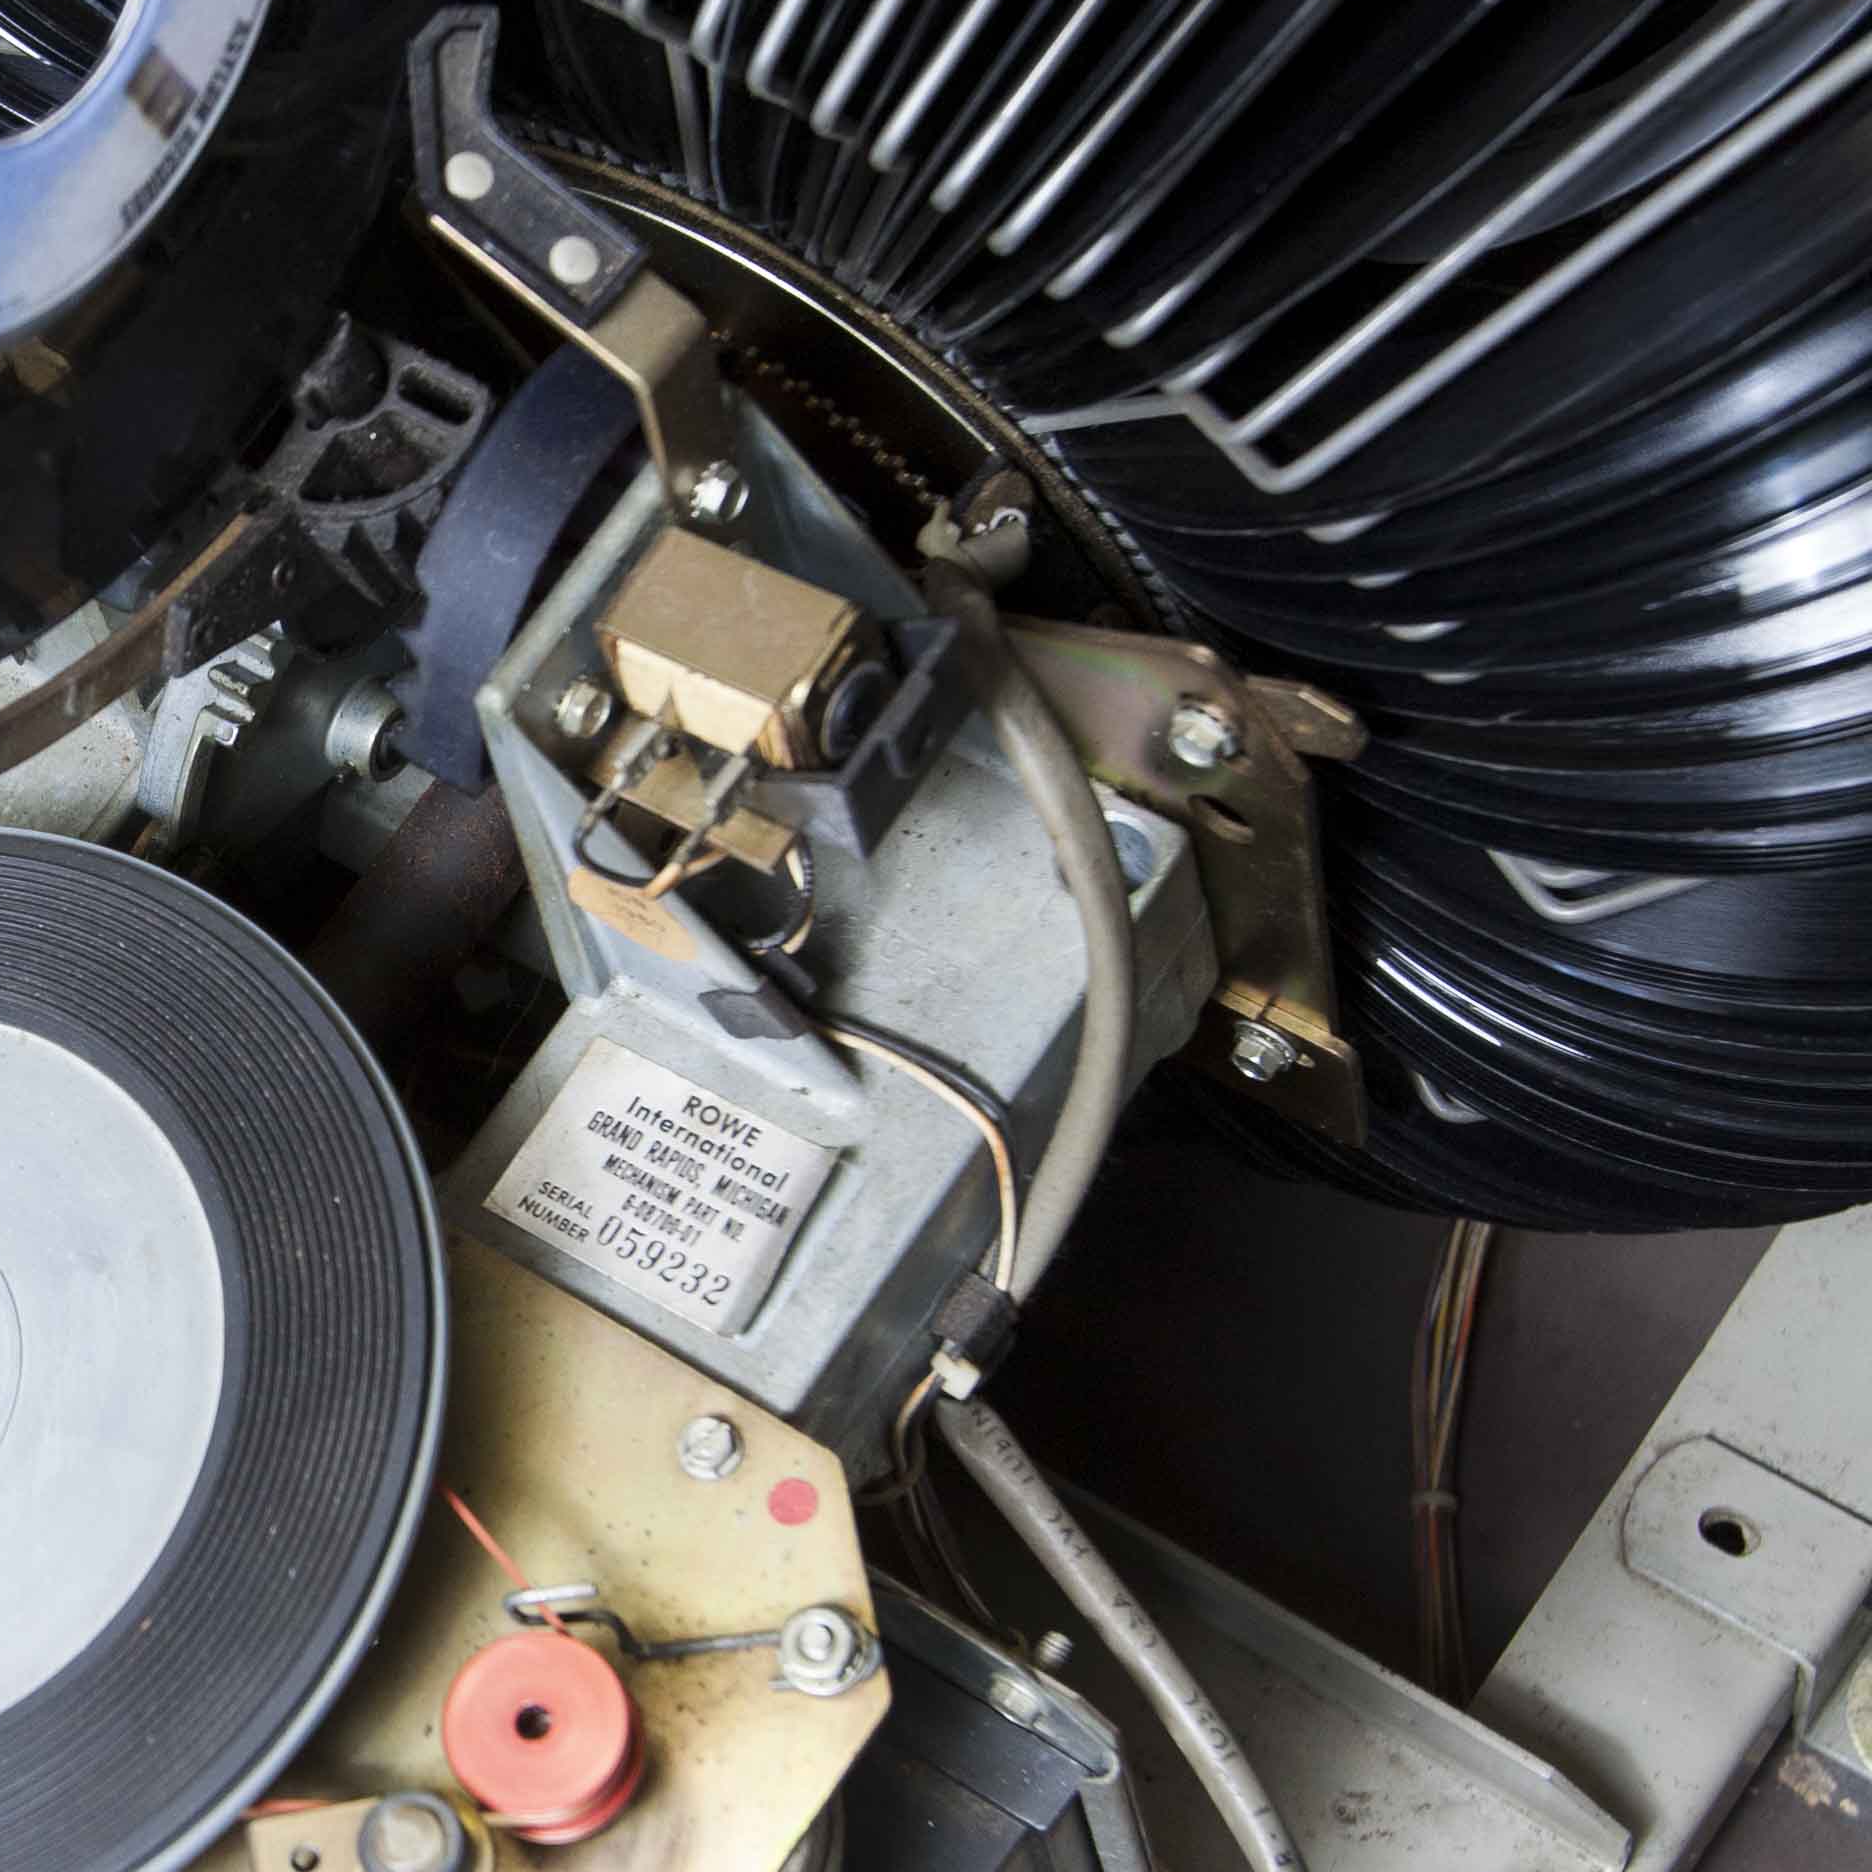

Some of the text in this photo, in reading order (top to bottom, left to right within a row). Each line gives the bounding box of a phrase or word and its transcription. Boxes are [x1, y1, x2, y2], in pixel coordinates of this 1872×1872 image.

[627, 1095, 790, 1192] International
[681, 1095, 763, 1148] ROWE
[537, 1180, 595, 1221] SERIAL
[587, 1110, 643, 1151] GRAND
[710, 1174, 791, 1228] MICHIGAN
[602, 1153, 679, 1206] MECHANISM
[683, 1195, 721, 1224] PART
[518, 1195, 732, 1306] NUMBER 059232
